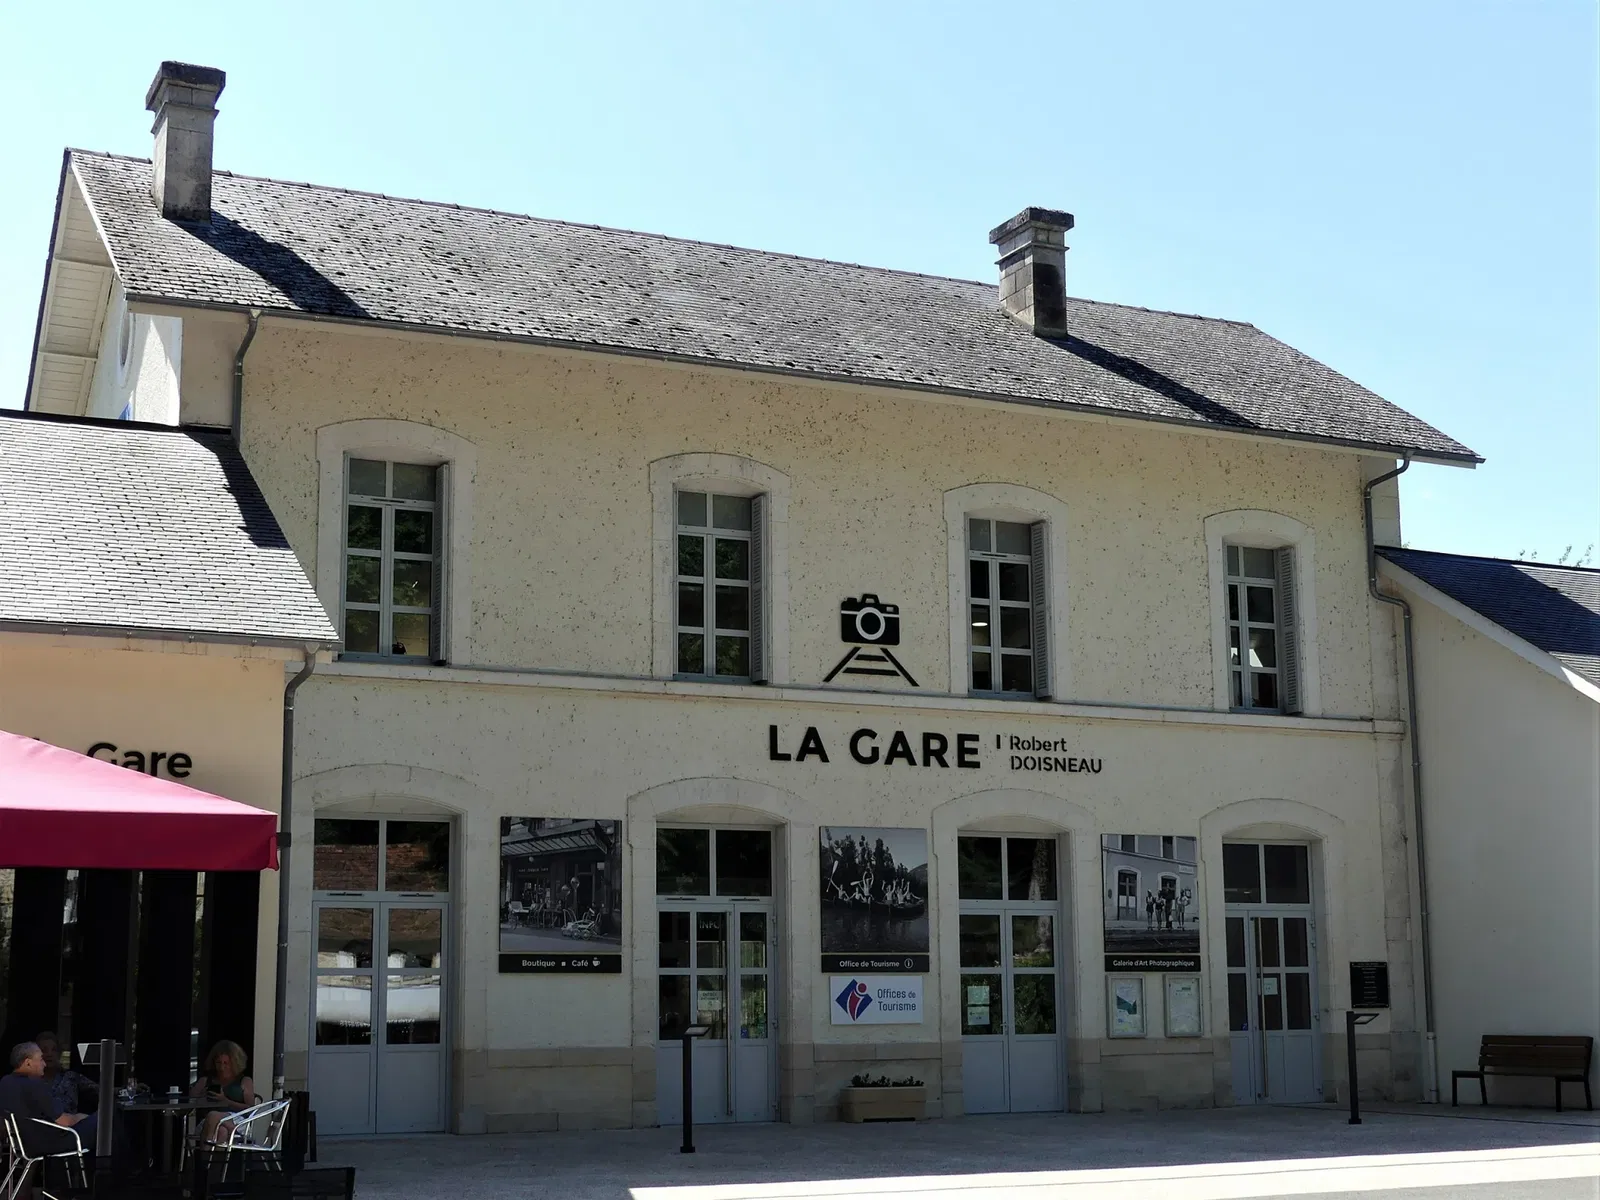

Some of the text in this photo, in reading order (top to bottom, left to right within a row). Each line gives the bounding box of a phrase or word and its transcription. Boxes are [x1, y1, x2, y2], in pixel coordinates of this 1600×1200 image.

[769, 725, 981, 769] LA GARE
[1010, 735, 1067, 753] Robert
[1010, 755, 1102, 774] DOISNEAU
[522, 960, 556, 968] Boutique
[1149, 960, 1195, 968] Photographique
[877, 988, 917, 999] Offices de
[877, 1001, 917, 1012] Tourisme
